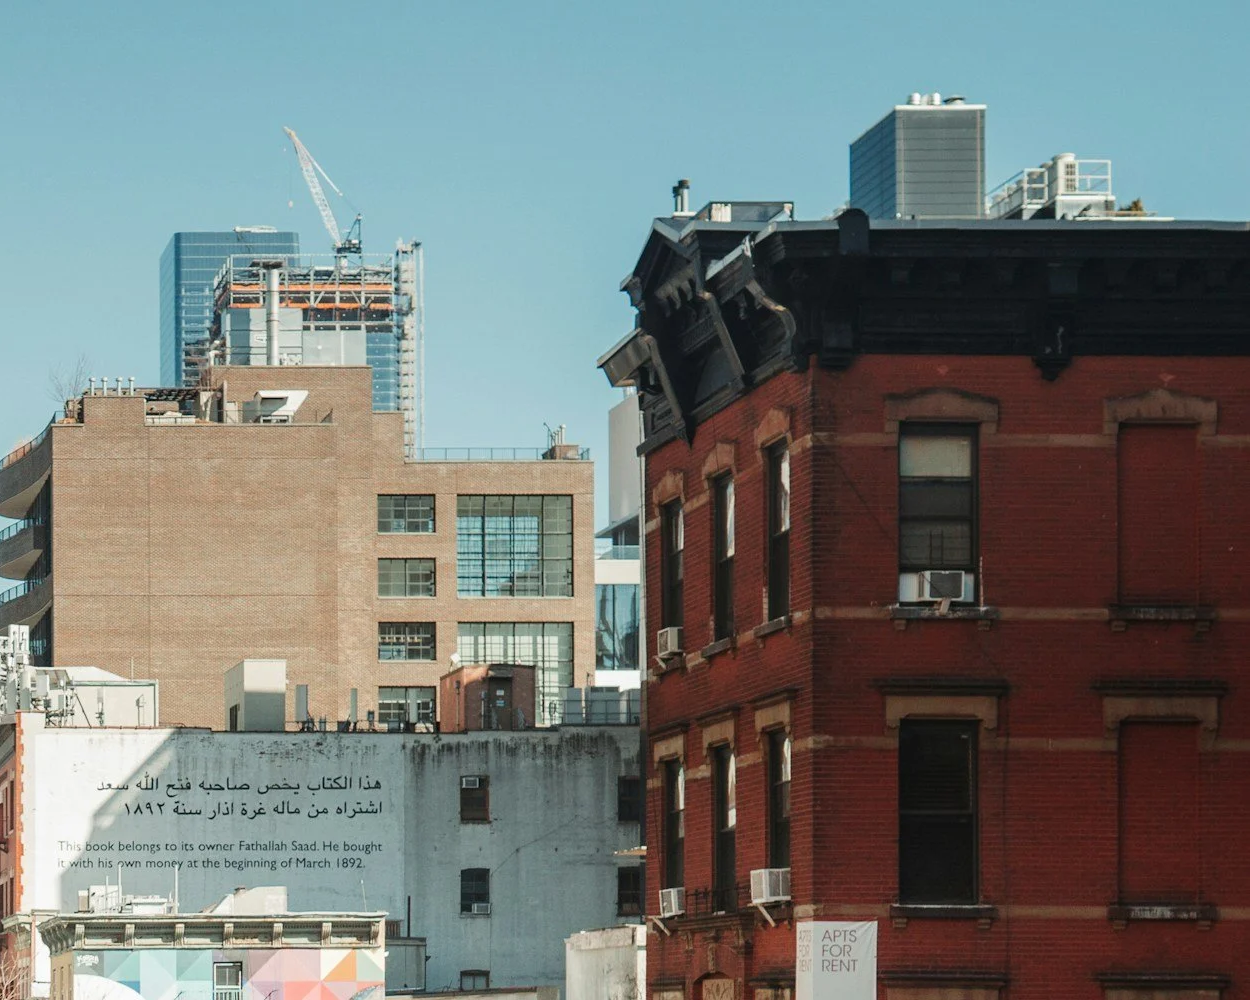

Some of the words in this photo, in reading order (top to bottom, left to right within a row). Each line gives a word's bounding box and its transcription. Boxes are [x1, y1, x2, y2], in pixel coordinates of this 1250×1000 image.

[96, 781, 129, 791] سعد
[136, 772, 159, 791] الله
[166, 777, 191, 798] فتح
[198, 777, 250, 795] صاحبه
[257, 777, 300, 795] يخص
[307, 775, 352, 796] الكتاب
[358, 774, 382, 790] هذا
[125, 801, 165, 815] ١٨٩٢
[173, 800, 202, 815] سنة
[208, 801, 234, 819] اذار
[241, 802, 267, 819] غرة
[273, 800, 300, 815] ماله
[307, 803, 328, 818] من
[335, 800, 382, 818] اشتراه
[58, 841, 81, 851] This
[85, 841, 114, 851] book
[118, 841, 161, 854] belongs
[165, 842, 177, 851] to
[181, 841, 194, 851] its
[239, 840, 287, 851] Fathallah
[291, 840, 320, 851] Saad.
[323, 841, 340, 851] He
[343, 840, 382, 854] bought
[57, 858, 66, 868] it
[69, 858, 94, 868] with
[98, 857, 113, 868] his
[118, 860, 142, 869] own
[145, 860, 182, 871] money
[187, 859, 198, 868] at
[202, 858, 220, 868] the
[224, 858, 277, 871] beginning
[280, 857, 293, 868] of
[295, 858, 331, 868] March
[336, 858, 366, 868] 1892.
[821, 930, 857, 943] APTS
[821, 944, 852, 957] FOR
[821, 959, 858, 972] RENT
